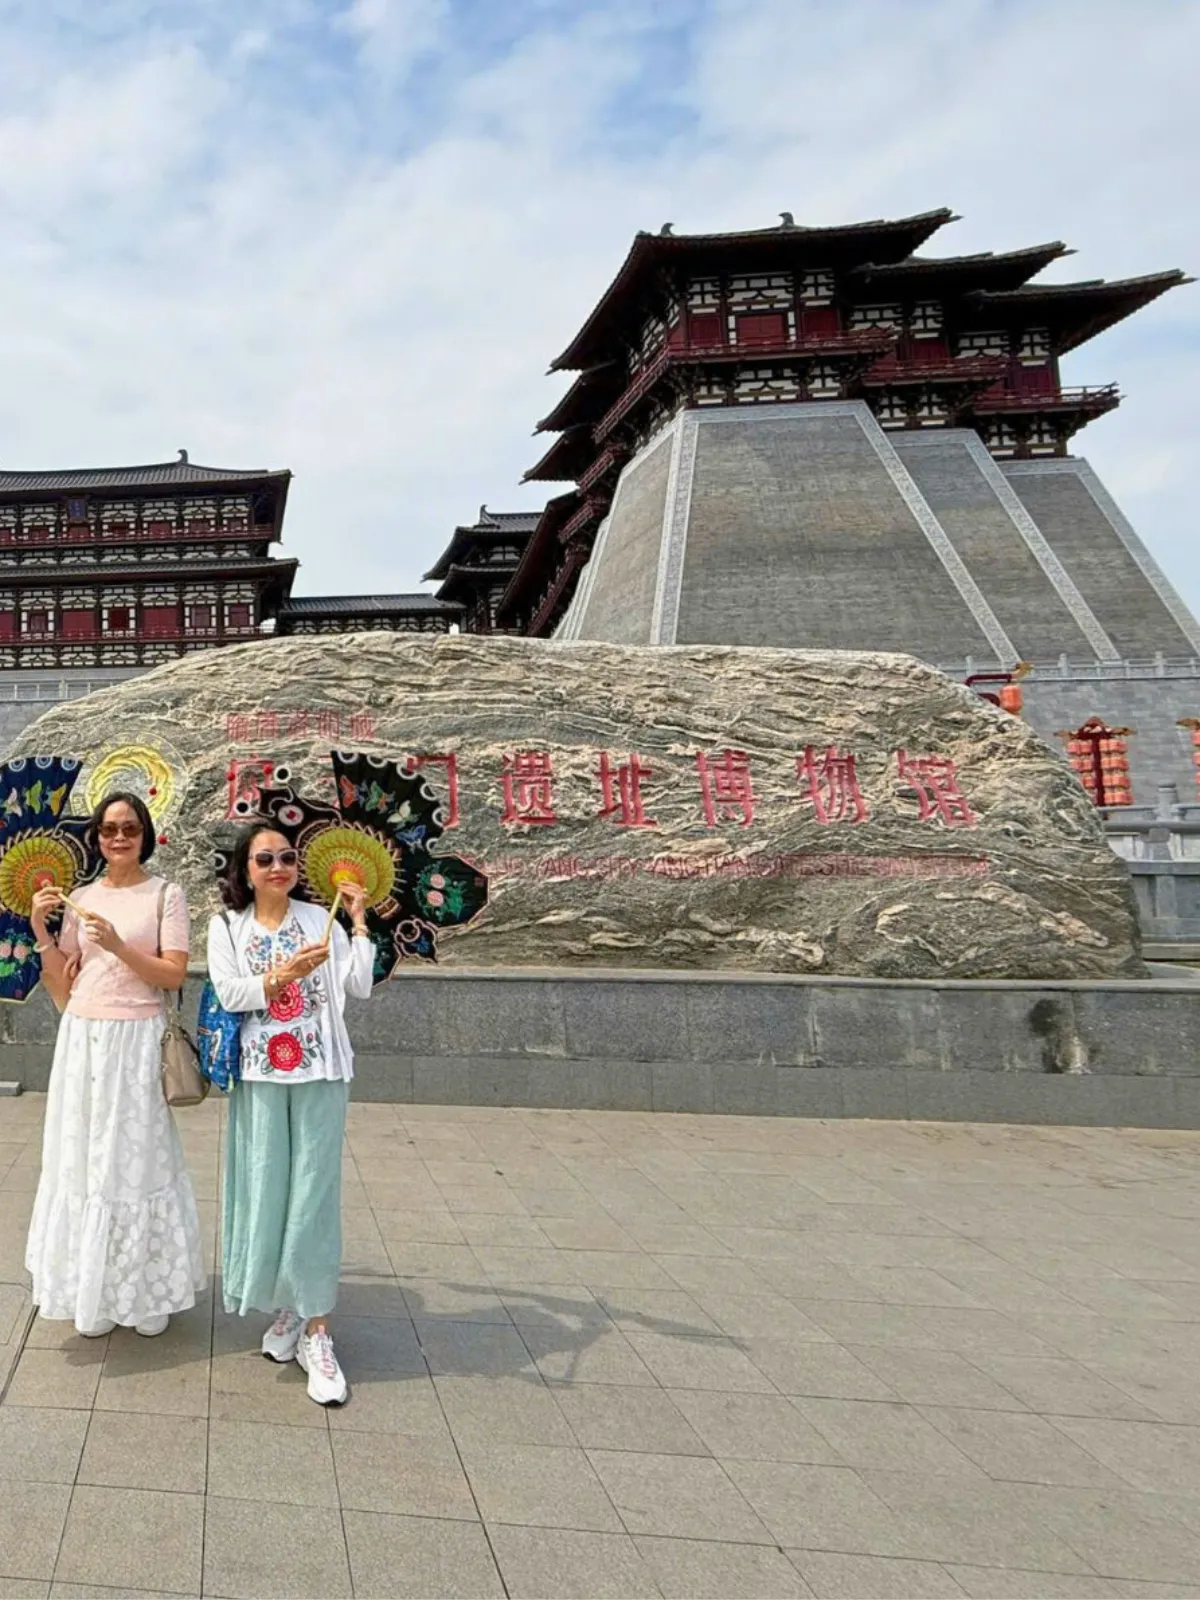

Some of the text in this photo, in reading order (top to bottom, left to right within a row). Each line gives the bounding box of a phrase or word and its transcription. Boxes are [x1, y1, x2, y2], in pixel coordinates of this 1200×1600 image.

[224, 745, 979, 828] 应门遗址博物馆
